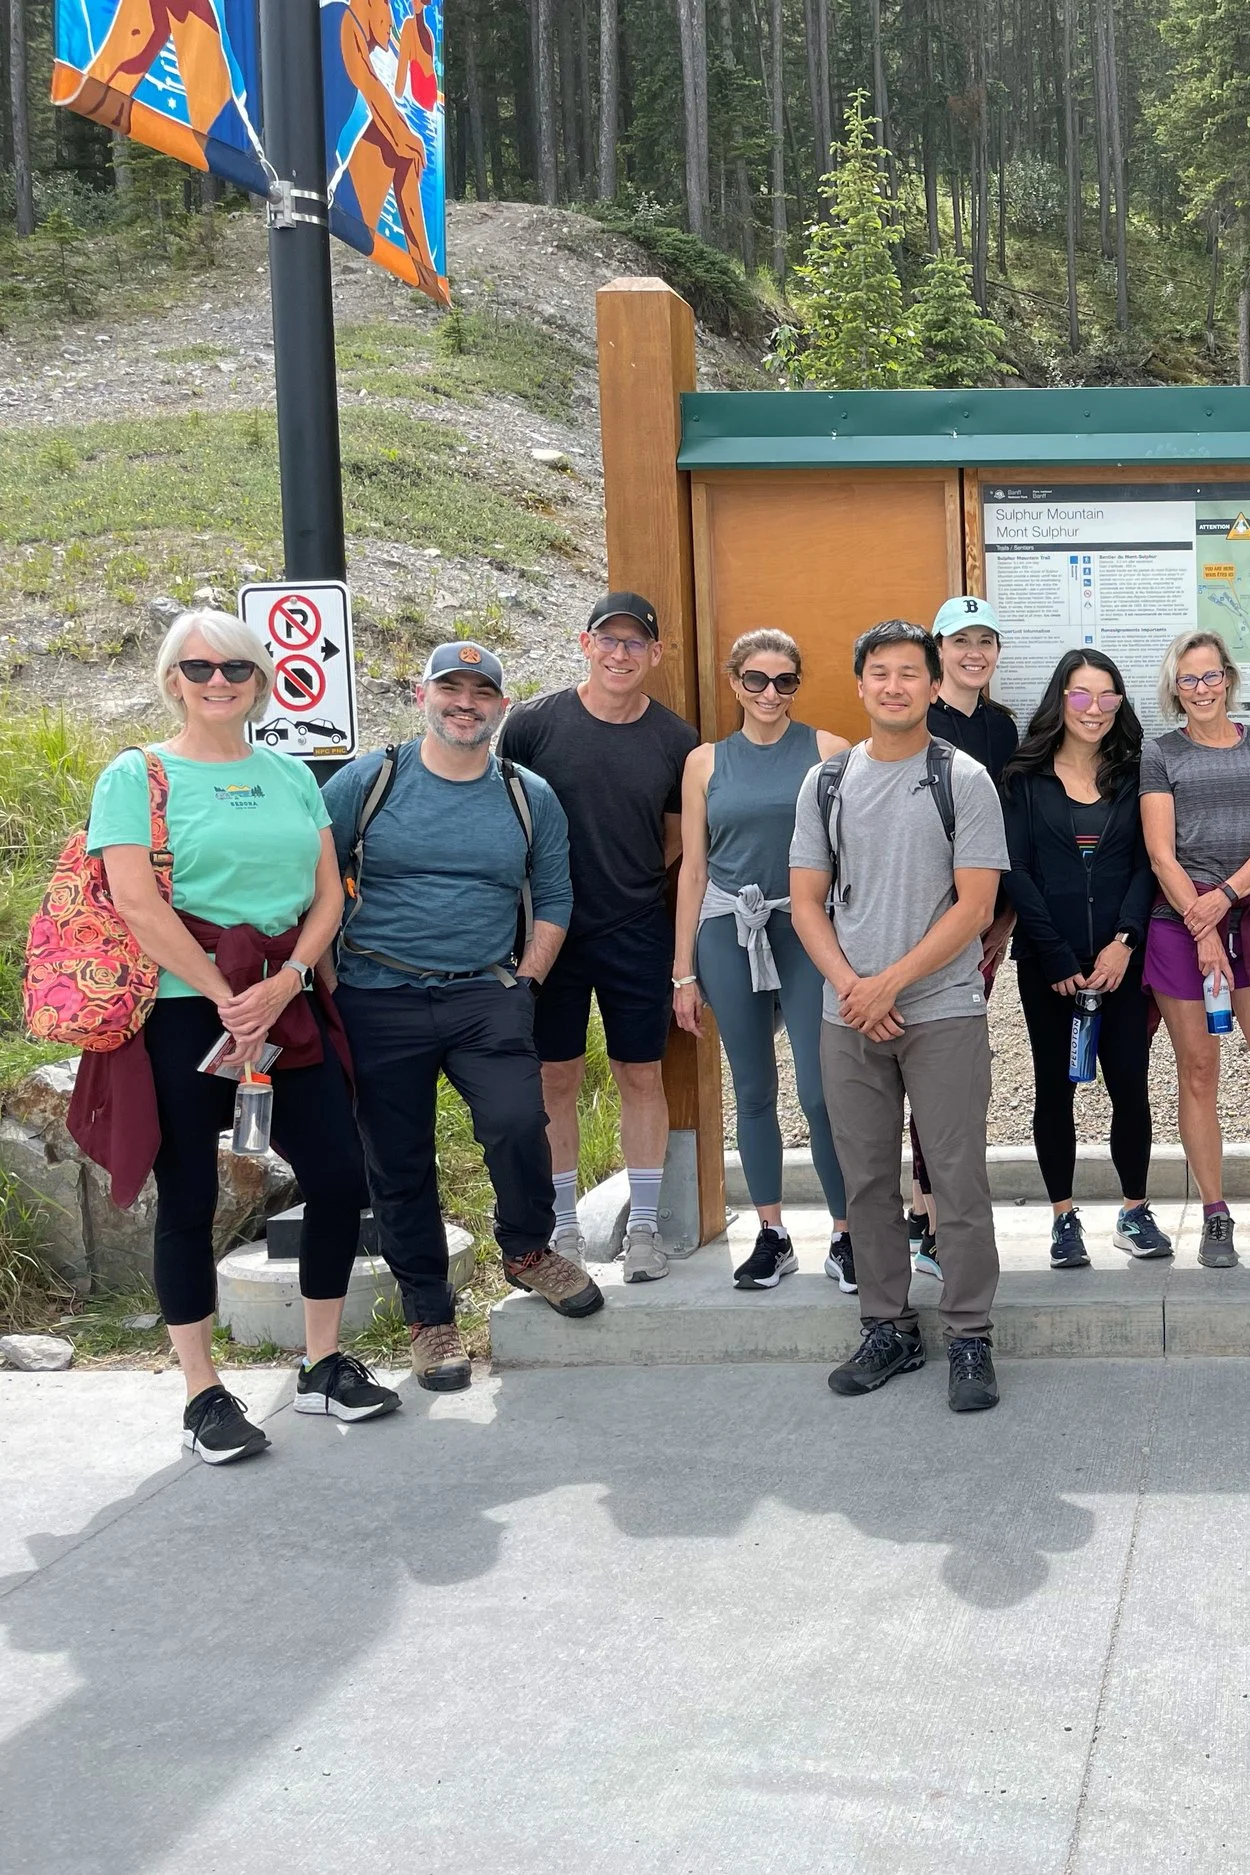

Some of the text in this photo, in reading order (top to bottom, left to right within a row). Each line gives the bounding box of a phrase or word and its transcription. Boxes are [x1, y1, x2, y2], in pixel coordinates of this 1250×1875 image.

[995, 507, 1104, 522] Sulphur Mountain
[996, 525, 1080, 540] Mont Sulphur
[1199, 523, 1230, 531] ATTENTION
[963, 599, 979, 614] B
[1071, 1019, 1080, 1067] PELOTON
